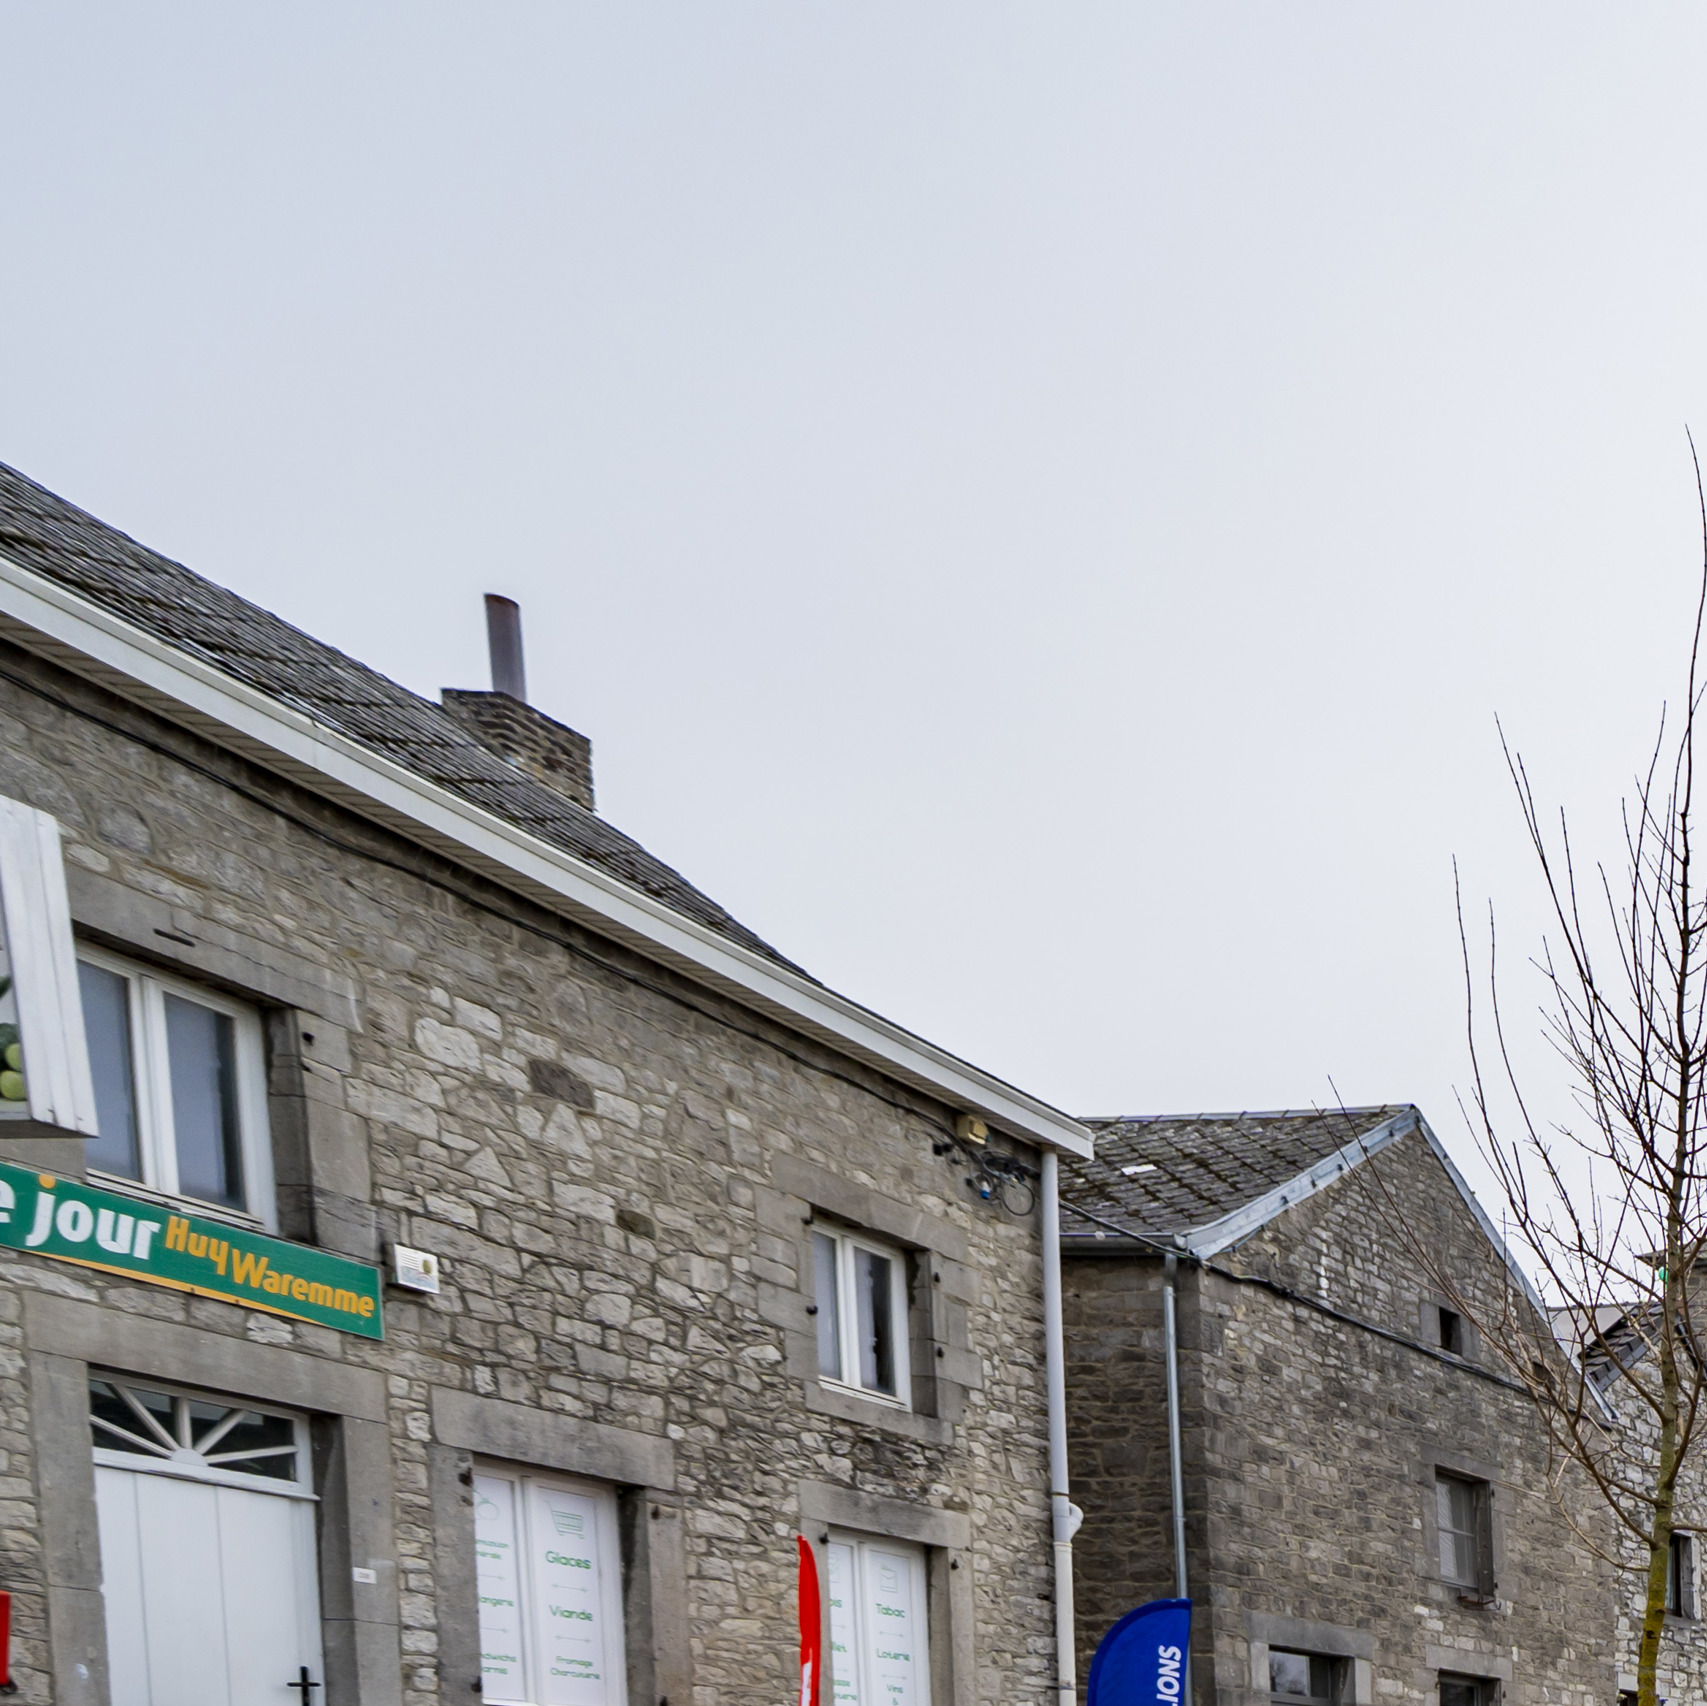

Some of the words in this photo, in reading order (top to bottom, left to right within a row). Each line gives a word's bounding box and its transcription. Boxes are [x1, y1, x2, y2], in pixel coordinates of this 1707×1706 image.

[25, 1174, 161, 1260] jour
[165, 1215, 229, 1276] Huy
[232, 1248, 375, 1318] Waremme
[545, 1550, 592, 1570] Glaces
[479, 1596, 514, 1608] angerie
[549, 1604, 594, 1621] Viande
[875, 1603, 906, 1618] Tabac
[876, 1647, 911, 1662] Loterie
[886, 1684, 904, 1695] Vins
